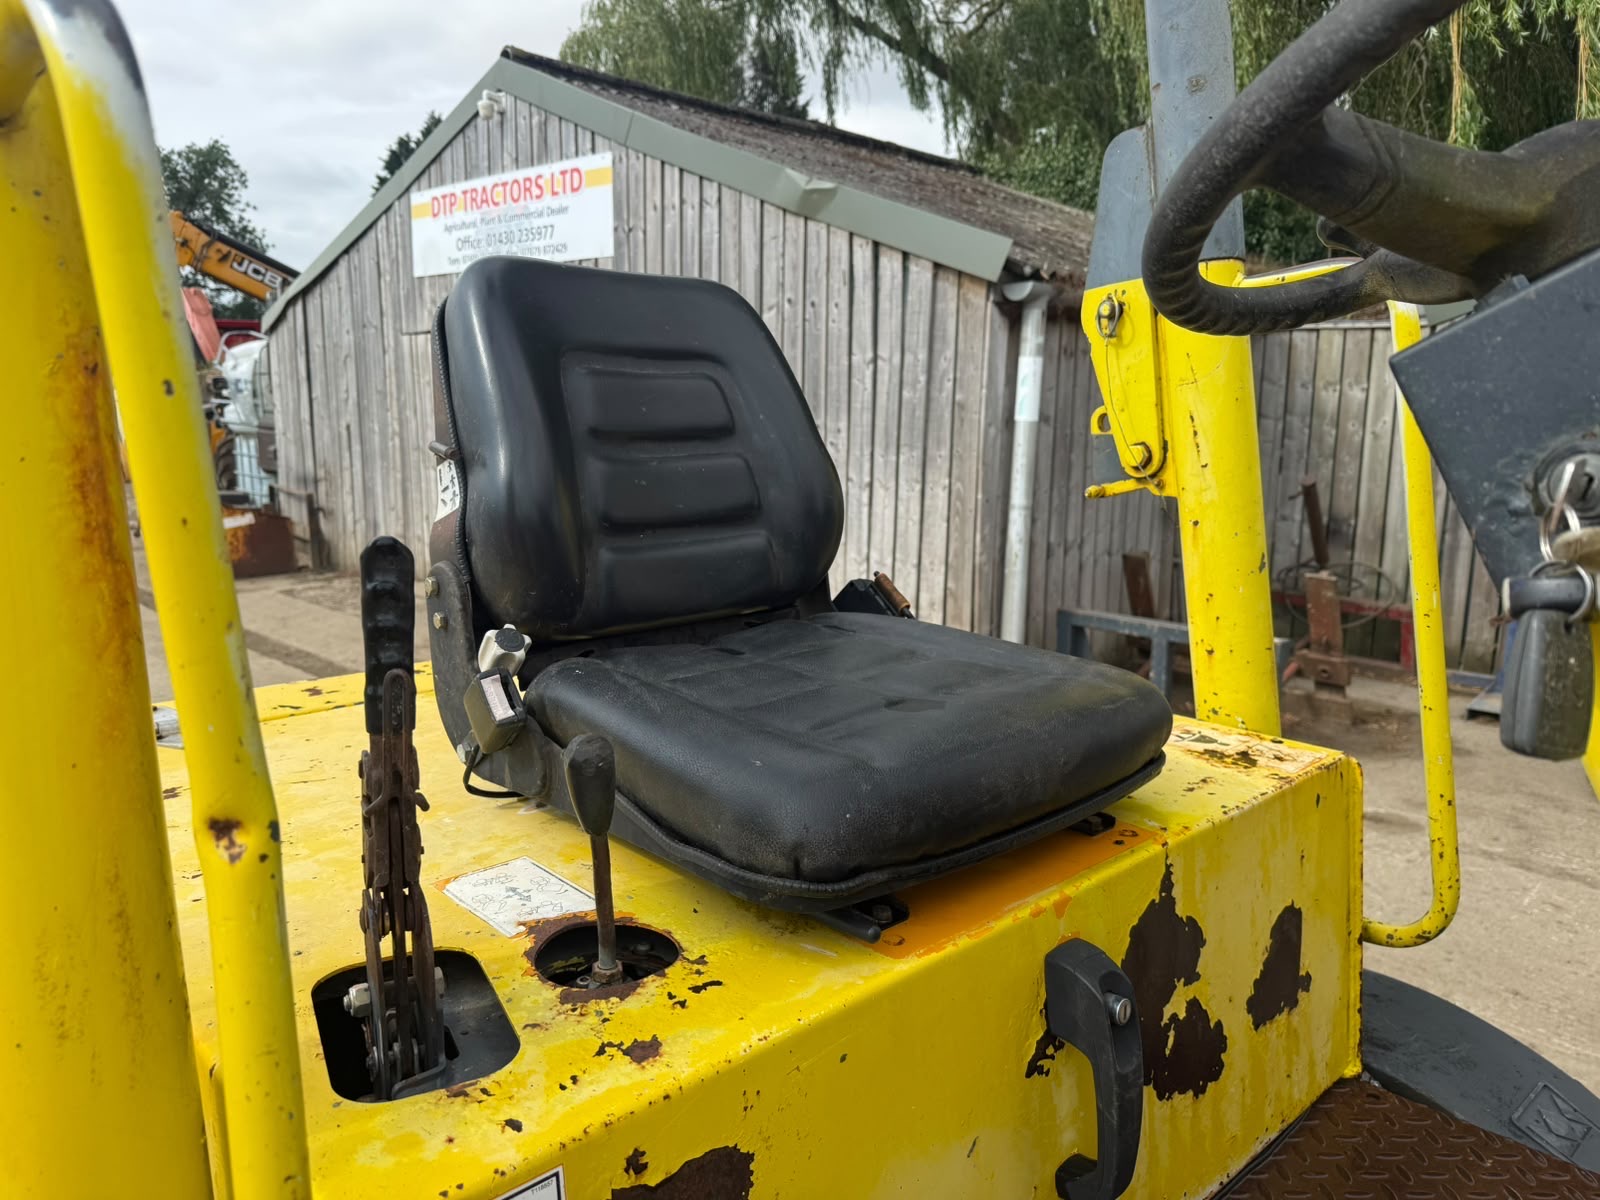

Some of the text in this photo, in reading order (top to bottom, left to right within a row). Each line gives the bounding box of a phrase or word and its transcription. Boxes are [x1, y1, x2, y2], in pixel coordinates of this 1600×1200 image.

[431, 168, 583, 218] DTP TRACTORS LTD
[480, 216, 496, 227] Plant
[497, 215, 504, 225] &
[504, 209, 544, 224] Commercial
[546, 205, 570, 217] Dealer
[486, 229, 516, 247] 01430
[518, 225, 555, 244] 235977
[231, 258, 283, 288] JCB
